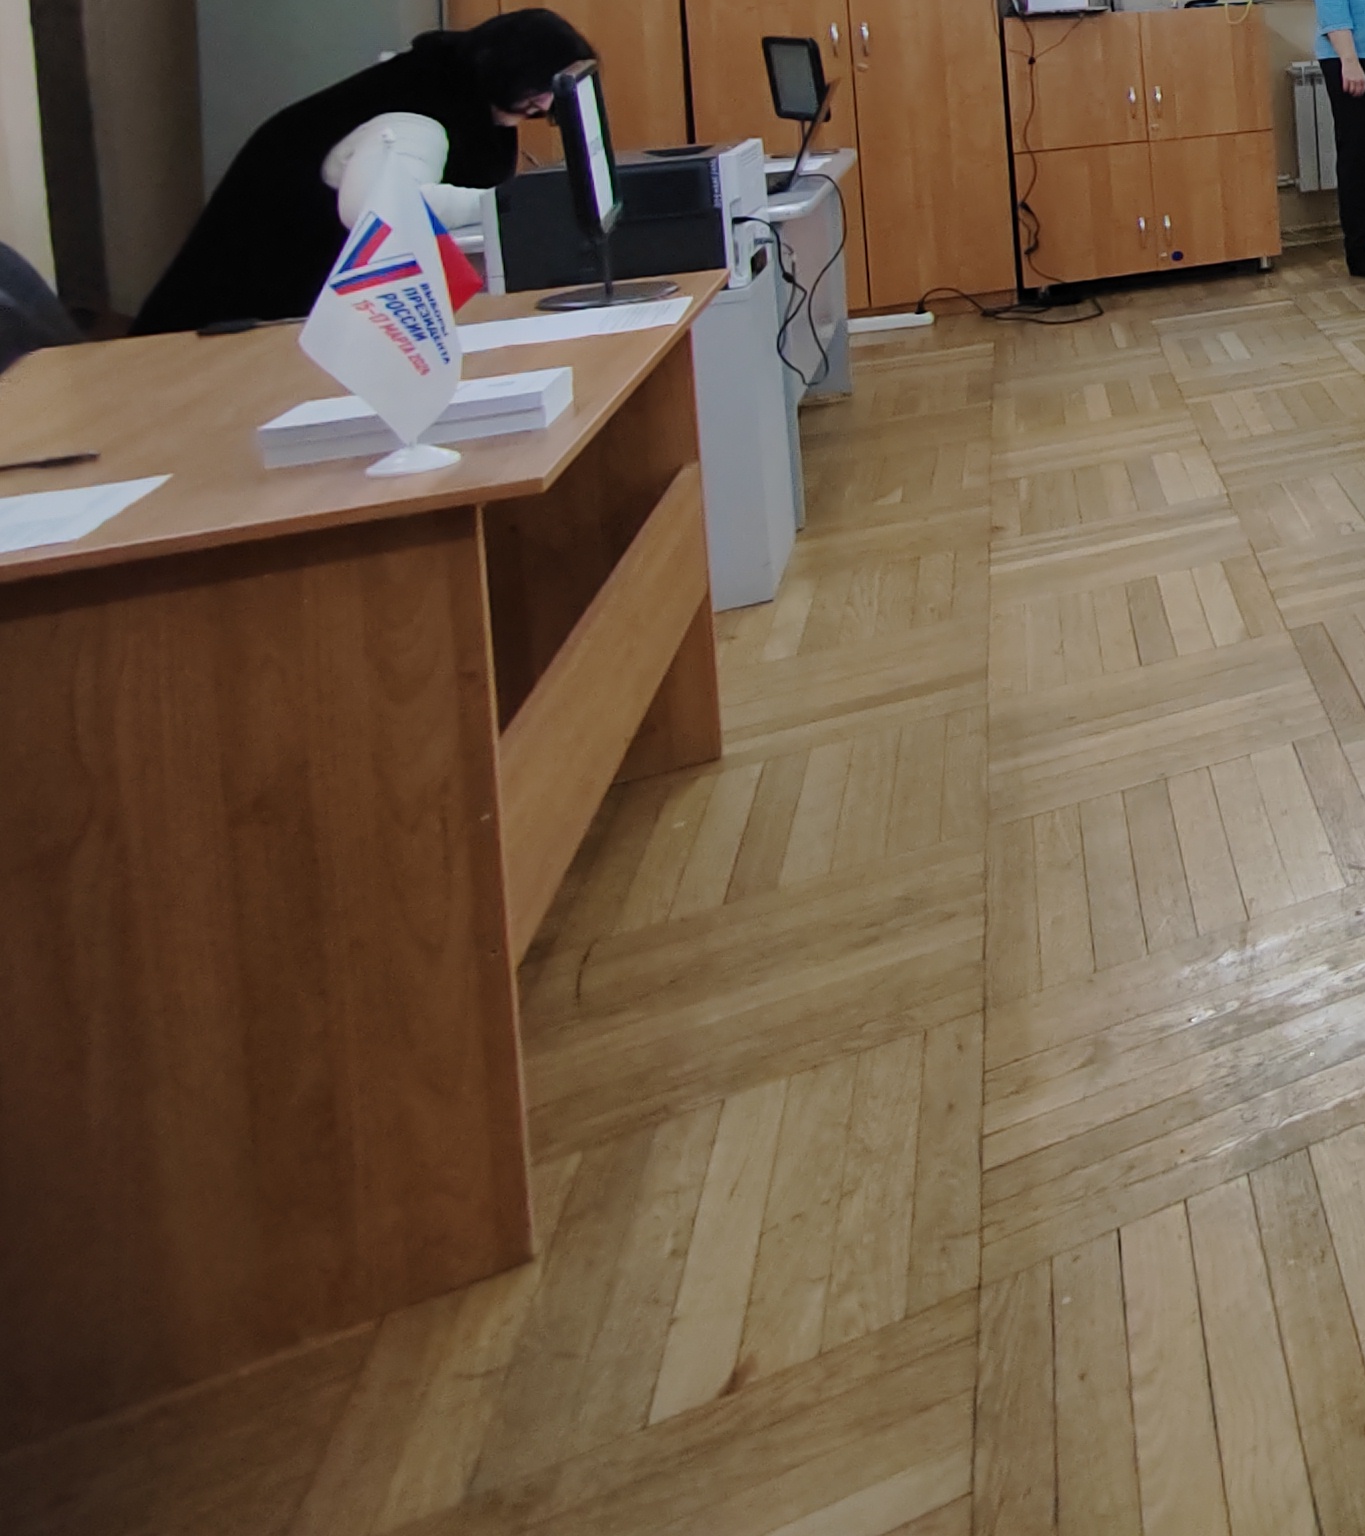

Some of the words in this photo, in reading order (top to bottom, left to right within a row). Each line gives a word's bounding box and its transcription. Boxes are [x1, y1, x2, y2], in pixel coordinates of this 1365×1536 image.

[376, 292, 428, 342] РОССИИ
[402, 286, 450, 364] ПРЕЗИДЕНТА
[419, 282, 449, 337] ВЫБОРЫ
[379, 321, 416, 356] МАРТА
[406, 353, 431, 377] 2024
